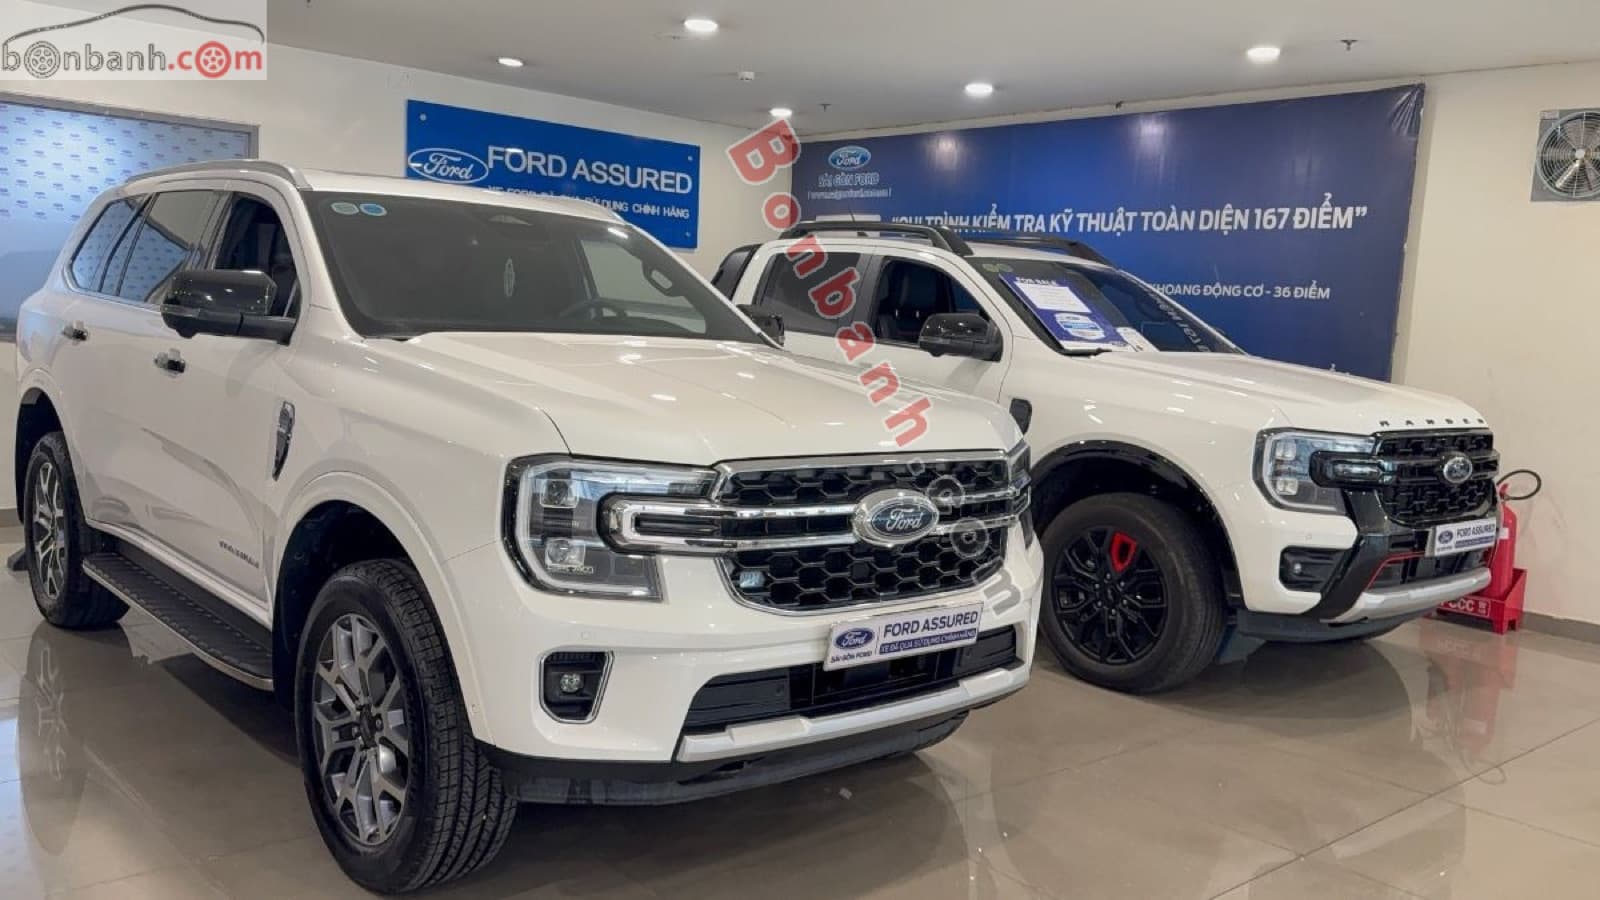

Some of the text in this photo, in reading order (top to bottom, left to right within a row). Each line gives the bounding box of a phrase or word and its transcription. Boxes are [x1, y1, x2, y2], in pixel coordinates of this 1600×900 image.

[423, 151, 473, 180] Ford
[487, 145, 567, 178] FORD
[572, 158, 693, 195] ASSURED
[1014, 214, 1046, 233] TRA
[1049, 208, 1074, 233] KỸ
[1076, 206, 1139, 237] THUẬT
[1140, 205, 1197, 232] TOÀN
[1199, 203, 1250, 236] DIỆN
[1254, 207, 1290, 230] 167
[1202, 282, 1242, 299] ĐỘNG
[1244, 283, 1265, 298] CƠ
[1273, 286, 1292, 298] 36
[1294, 280, 1331, 300] ĐIỂM
[885, 507, 924, 532] Ford
[883, 611, 978, 638] FORD ASSURED
